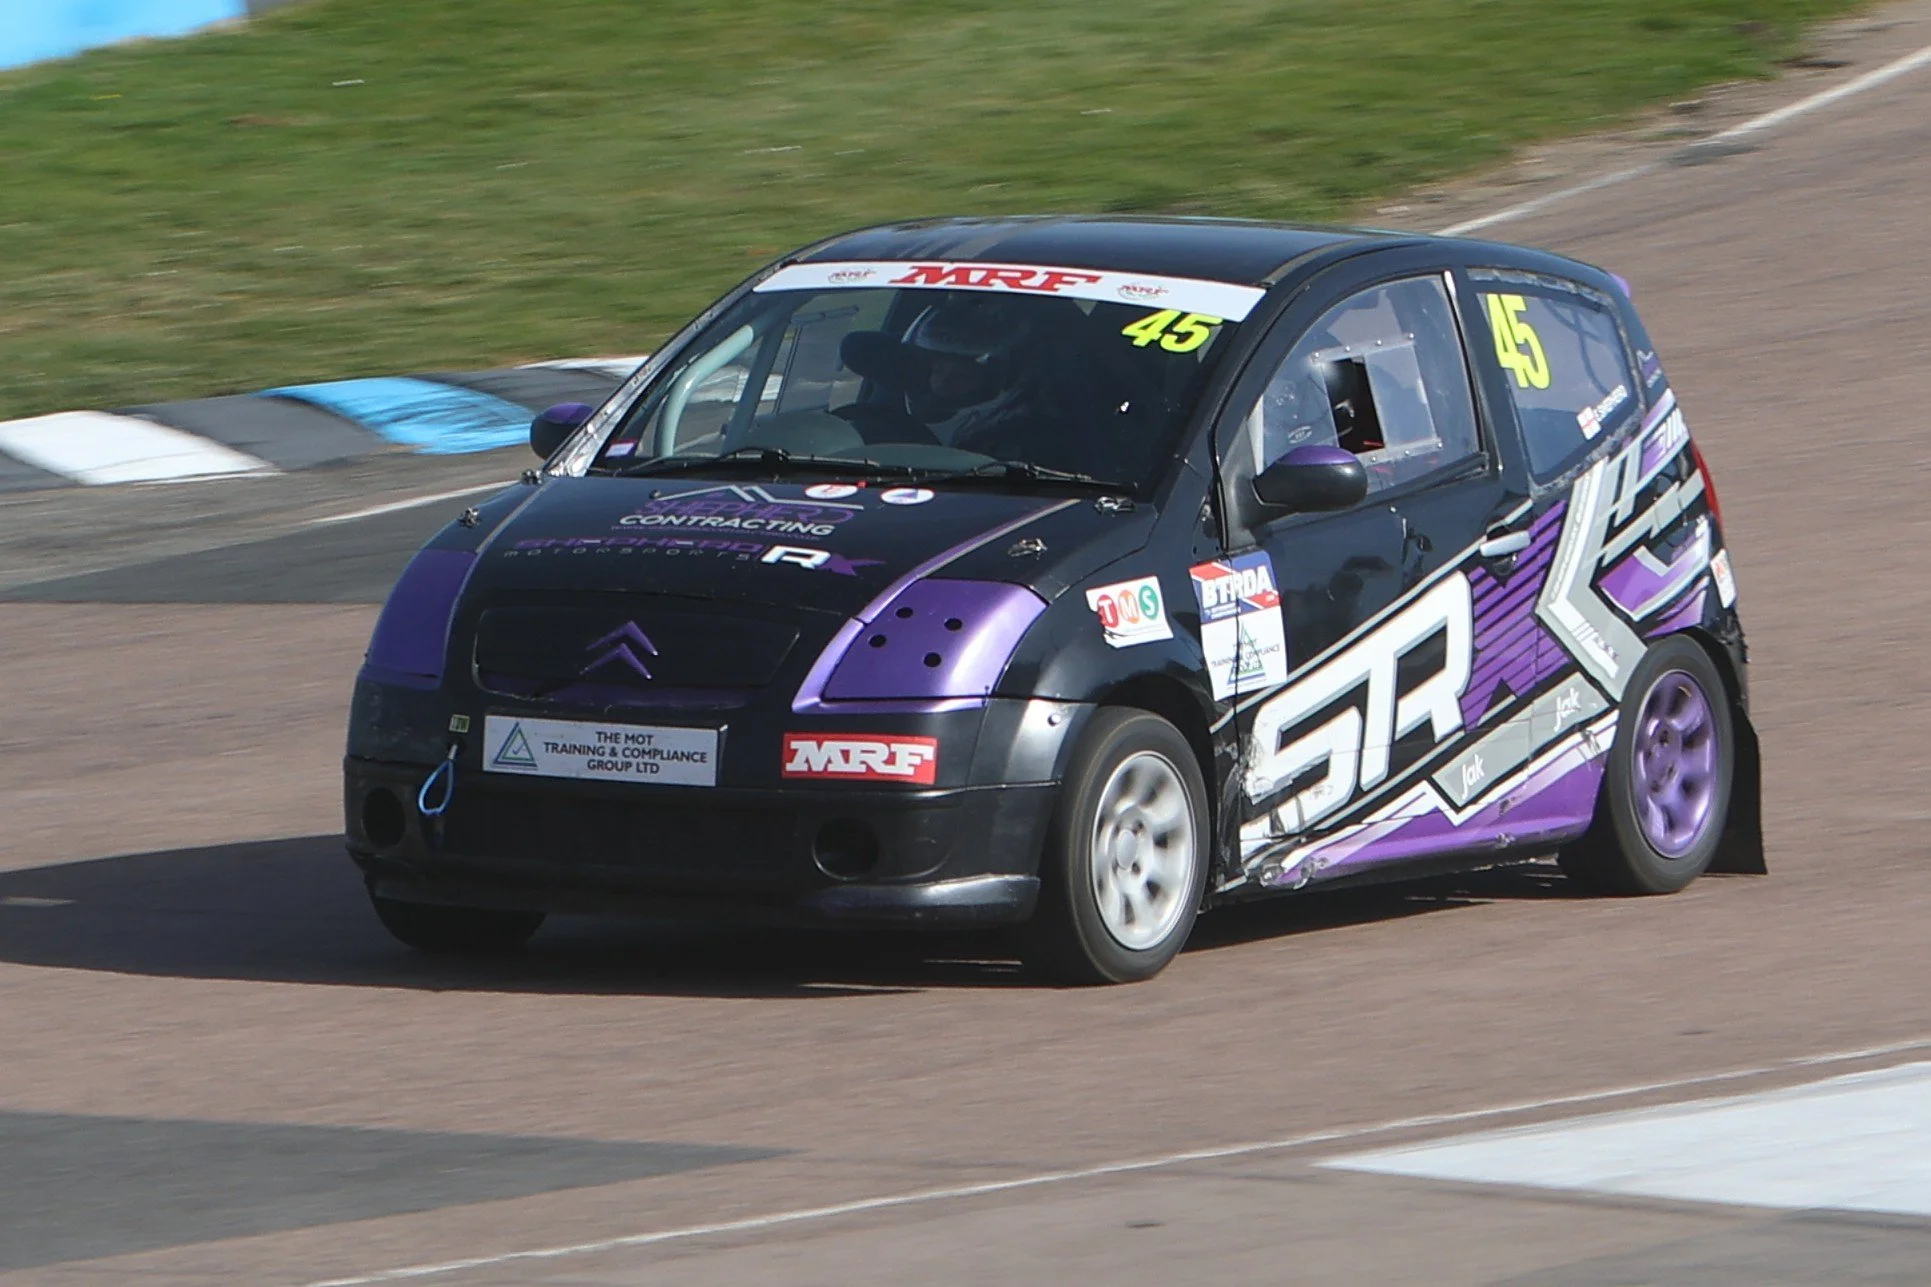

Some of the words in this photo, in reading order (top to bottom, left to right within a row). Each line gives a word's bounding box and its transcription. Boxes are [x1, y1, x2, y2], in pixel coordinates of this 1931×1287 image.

[888, 265, 1102, 292] MRF
[1121, 308, 1224, 353] 45
[1486, 293, 1550, 389] 45
[618, 514, 835, 536] CONTRACTING
[1201, 565, 1274, 609] BTRDA
[1097, 588, 1157, 625] TMS
[543, 741, 606, 758] TRAINING
[608, 746, 619, 759] &
[621, 747, 708, 764] COMPLIANCE
[595, 731, 622, 745] THE
[624, 734, 655, 746] MOT
[586, 758, 633, 772] GROUP
[635, 762, 661, 775] LTD
[785, 739, 936, 775] MRF
